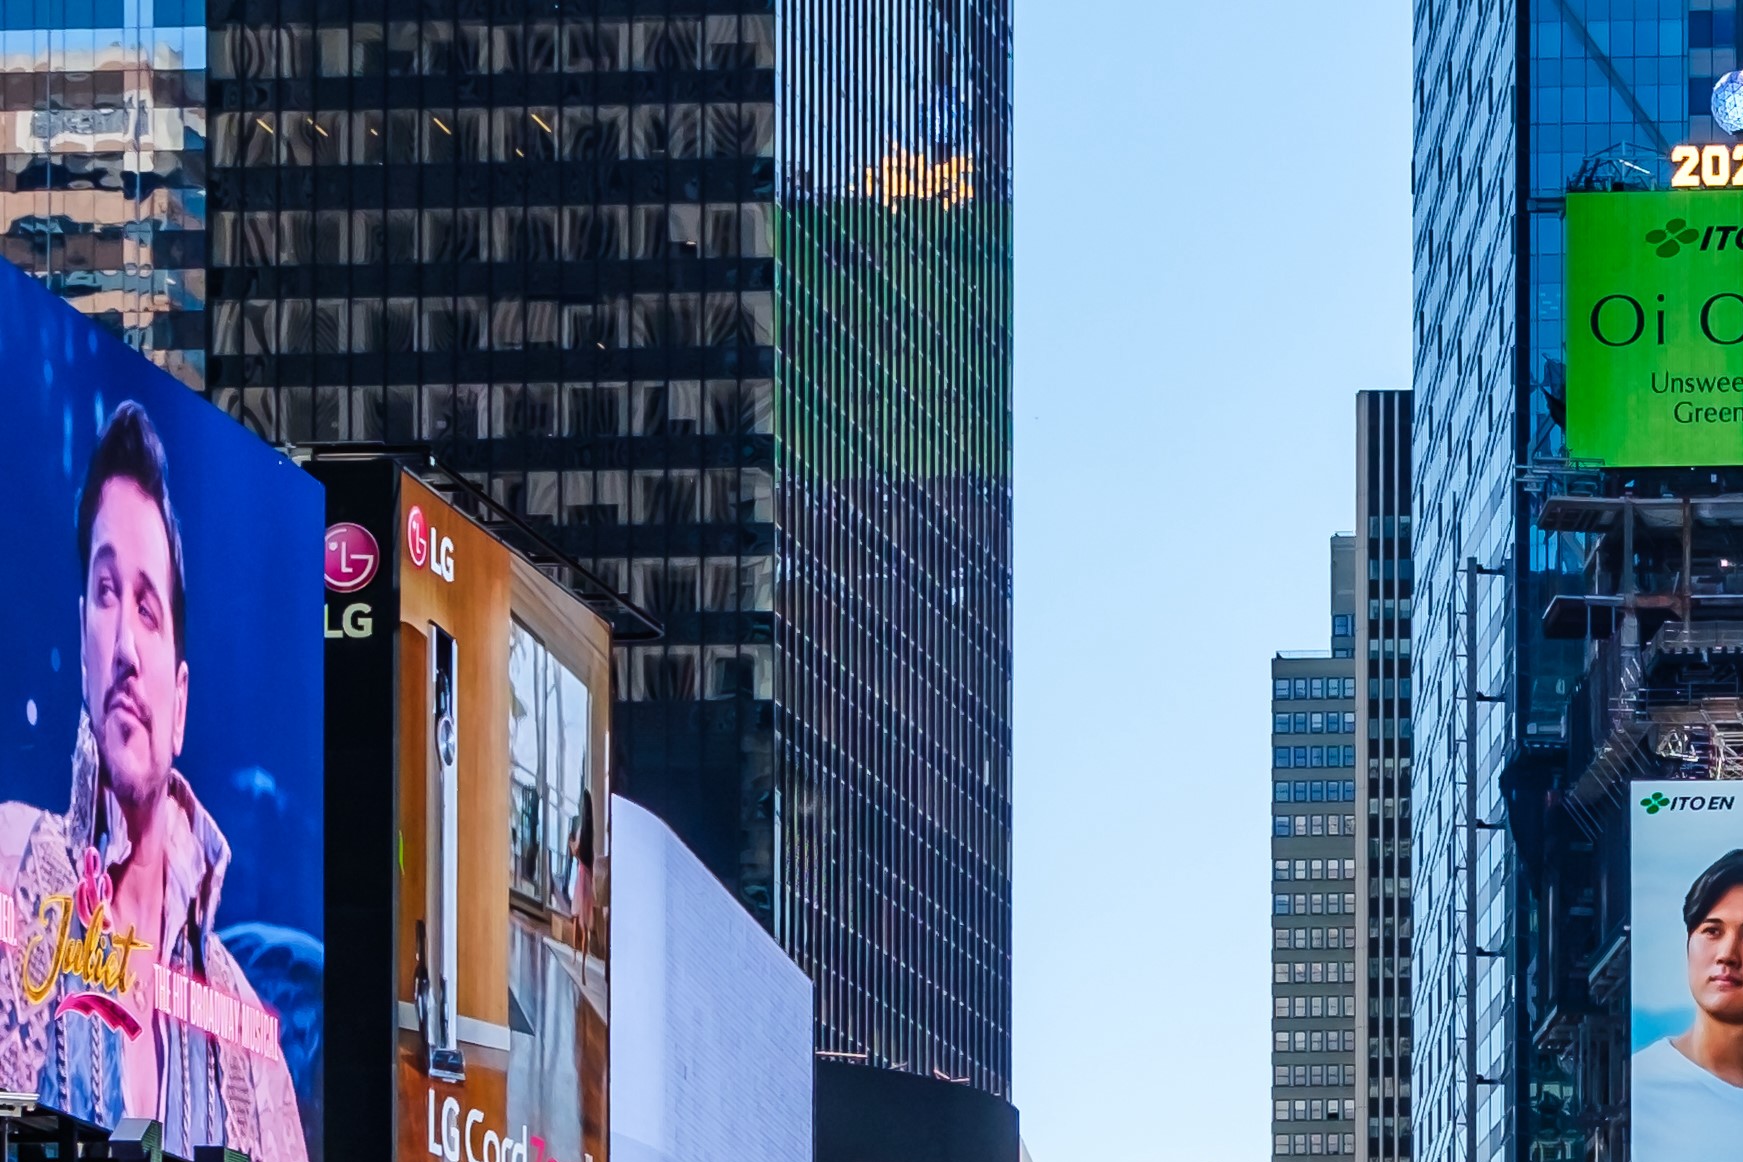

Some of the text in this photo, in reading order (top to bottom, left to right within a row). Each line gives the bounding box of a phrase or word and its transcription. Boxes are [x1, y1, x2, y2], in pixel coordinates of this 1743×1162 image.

[1590, 294, 1665, 346] Oi
[430, 526, 455, 583] LG
[324, 602, 373, 638] LG
[1670, 796, 1735, 811] ITO EN
[22, 893, 153, 1006] Juliet
[428, 1088, 460, 1162] LG
